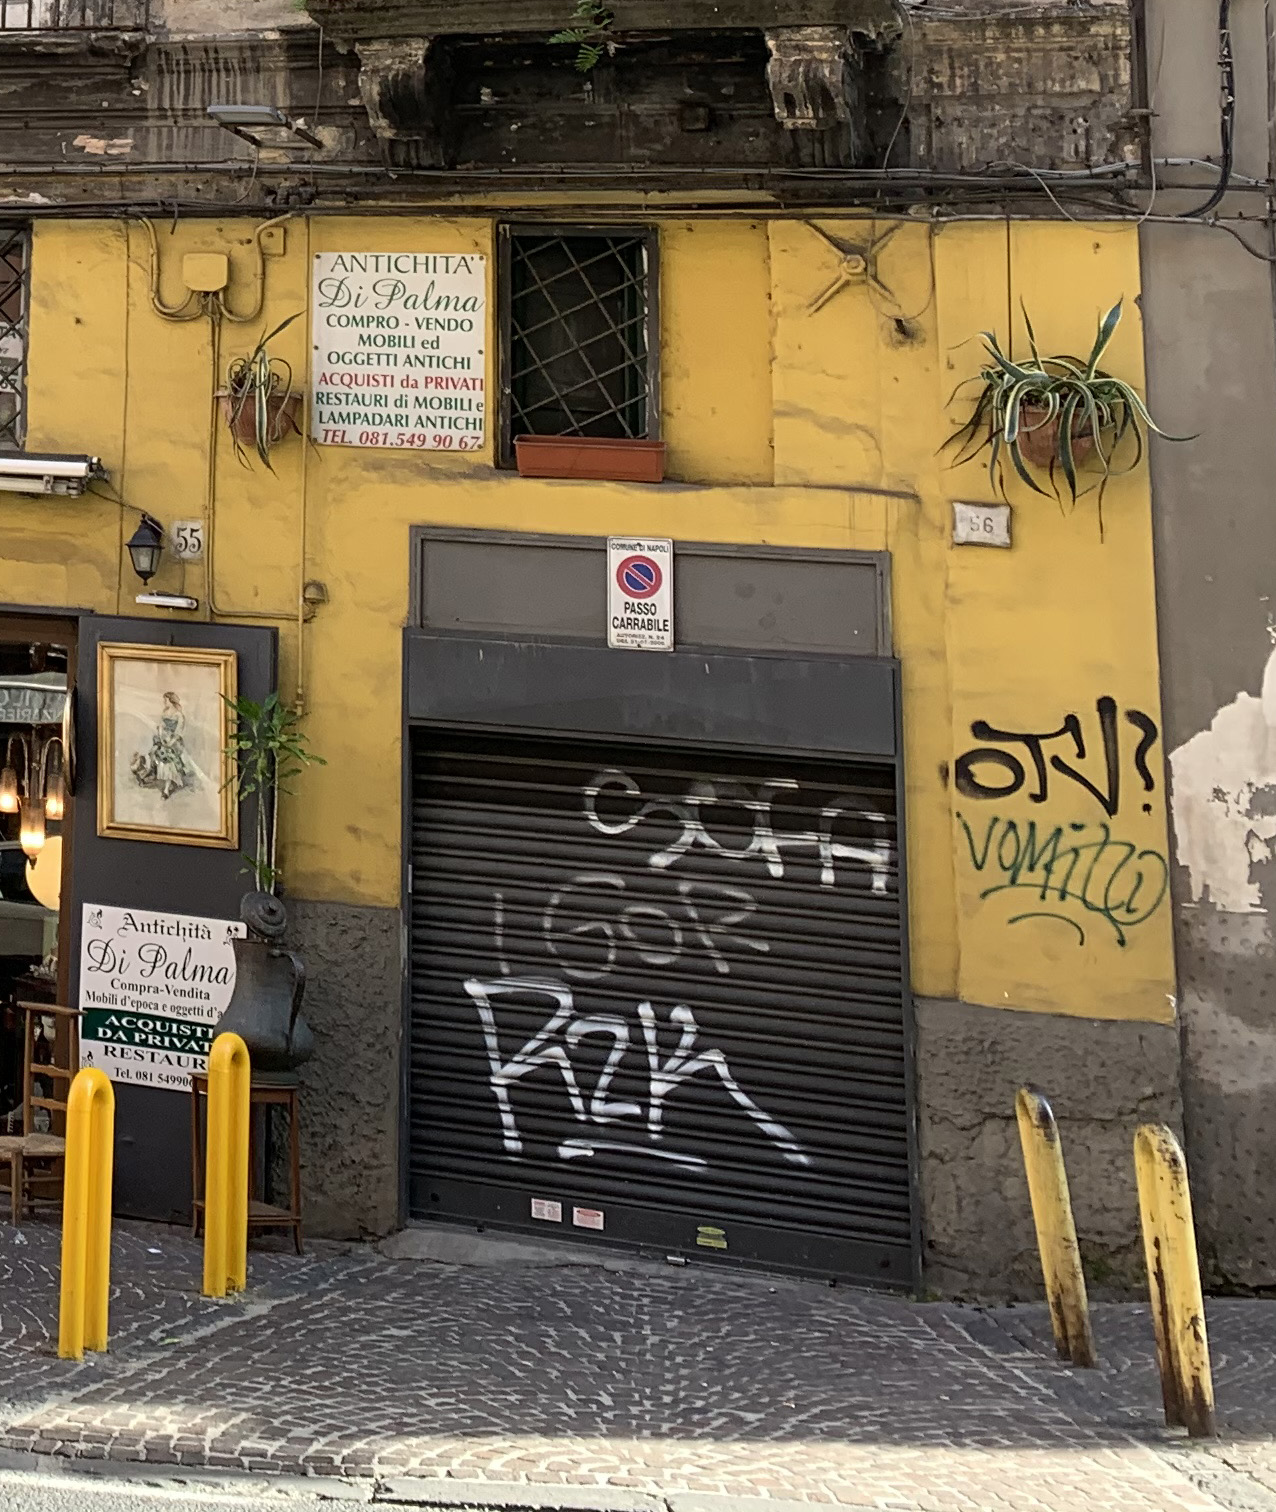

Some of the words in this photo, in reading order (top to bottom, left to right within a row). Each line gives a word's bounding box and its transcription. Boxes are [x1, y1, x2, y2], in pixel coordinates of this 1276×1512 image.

[331, 255, 474, 274] ANTICHITA'
[318, 277, 369, 308] Di
[372, 279, 484, 312] Palma
[326, 314, 399, 329] COMPRO
[415, 317, 473, 332] VENDO
[357, 334, 416, 349] MOBILI
[421, 335, 440, 350] ed
[327, 352, 398, 367] OGGETTI
[403, 354, 471, 370] ANTICHI
[318, 372, 395, 390] ACQUISTI
[400, 374, 418, 389] da
[424, 377, 484, 392] PRIVATI
[316, 392, 388, 408] RESTAURI
[394, 394, 408, 408] di
[413, 396, 472, 411] MOBILI
[476, 401, 484, 412] e
[317, 411, 409, 427] LAMPADARI
[414, 414, 483, 431] ANTICHI
[321, 429, 352, 444] TEL.
[359, 430, 426, 447] 081.549
[432, 433, 453, 449] 90
[458, 434, 480, 450] 67
[970, 515, 994, 533] 56
[176, 527, 201, 554] 55
[624, 602, 657, 616] PASSO
[612, 617, 669, 632] CARRABILE
[117, 912, 212, 942] Antichità
[87, 938, 131, 974] Di
[138, 942, 234, 985] Palma
[110, 978, 210, 1001] Compra-Vendita
[85, 990, 118, 1006] Mobili
[120, 994, 159, 1012] d'epoca
[162, 1003, 168, 1012] e
[170, 1002, 204, 1018] oggetti
[207, 1007, 223, 1019] d'a
[104, 1015, 213, 1038] ACQUISTI
[97, 1027, 128, 1042] DA
[134, 1033, 212, 1053] PRIVAT
[104, 1045, 207, 1070] RESTAUR
[114, 1067, 133, 1080] Tel.
[135, 1070, 153, 1082] 081
